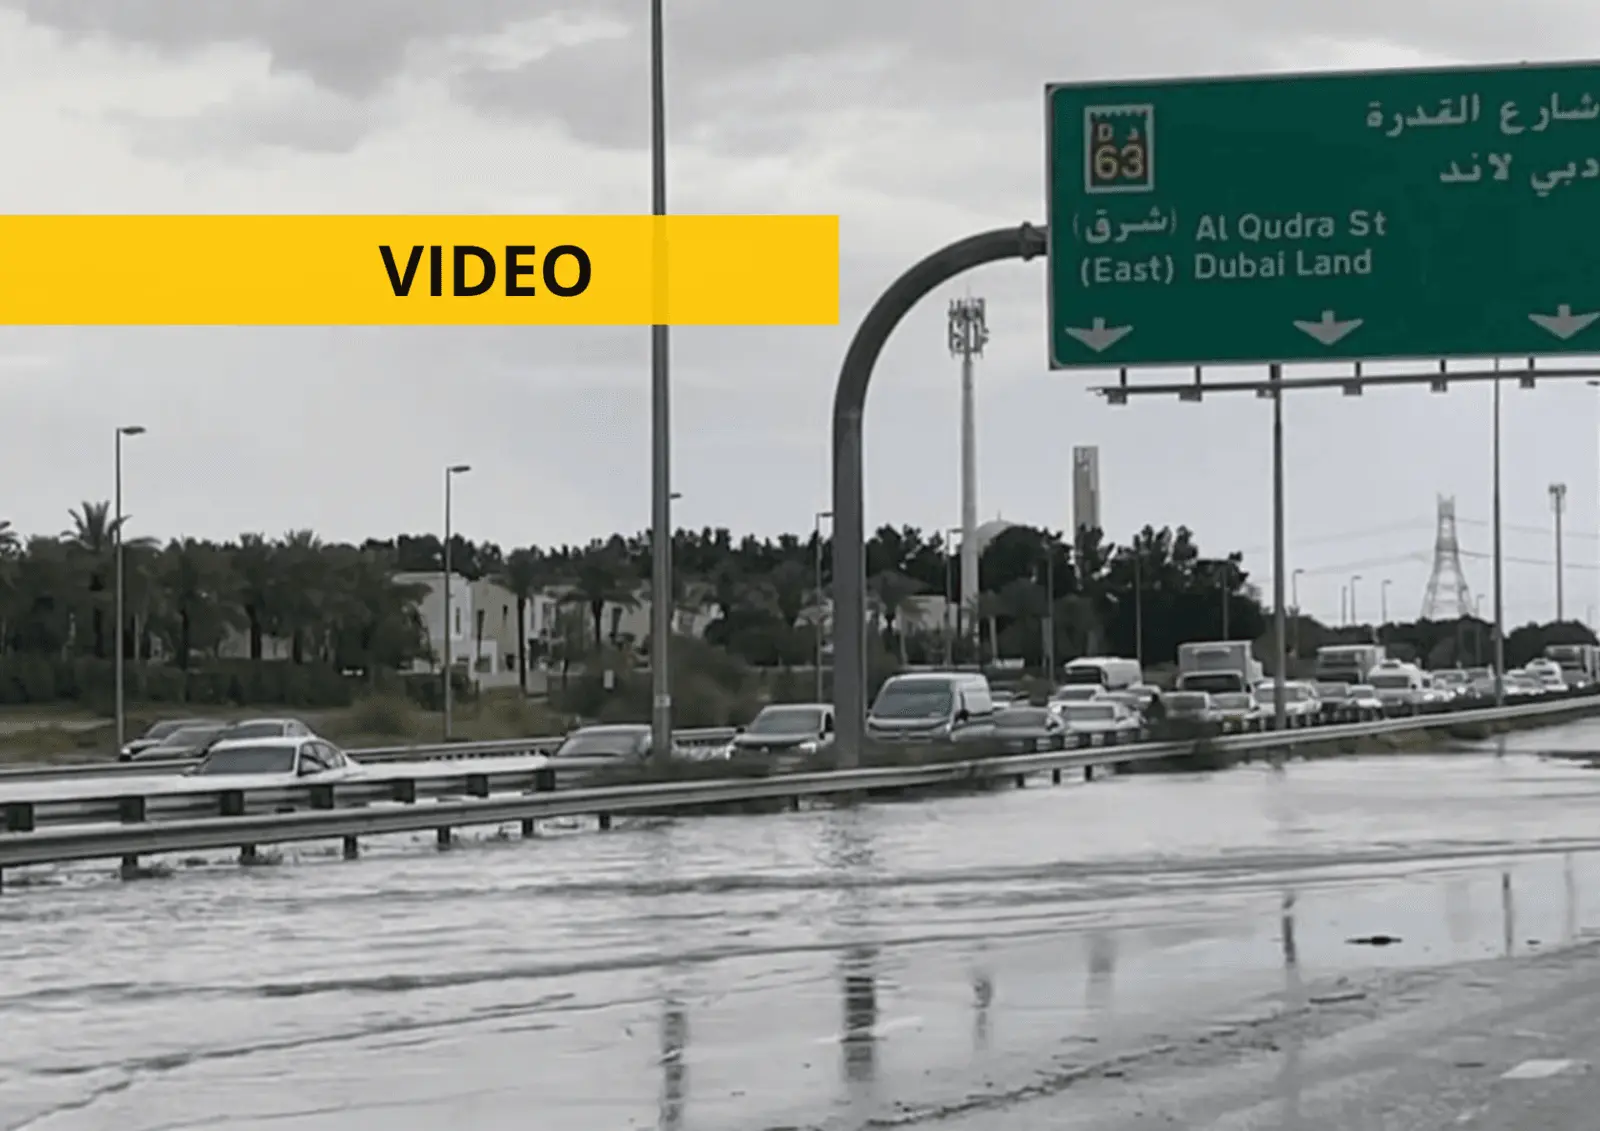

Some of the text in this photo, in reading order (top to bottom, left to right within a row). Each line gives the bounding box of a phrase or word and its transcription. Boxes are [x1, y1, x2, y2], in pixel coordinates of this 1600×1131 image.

[1366, 92, 1600, 138] شارع القدرة
[1094, 143, 1144, 179] 63
[1439, 152, 1600, 198] دبي لاند
[1196, 209, 1387, 242] Al Qudra St
[1080, 254, 1174, 288] (East)
[1194, 248, 1372, 280] Dubai Land
